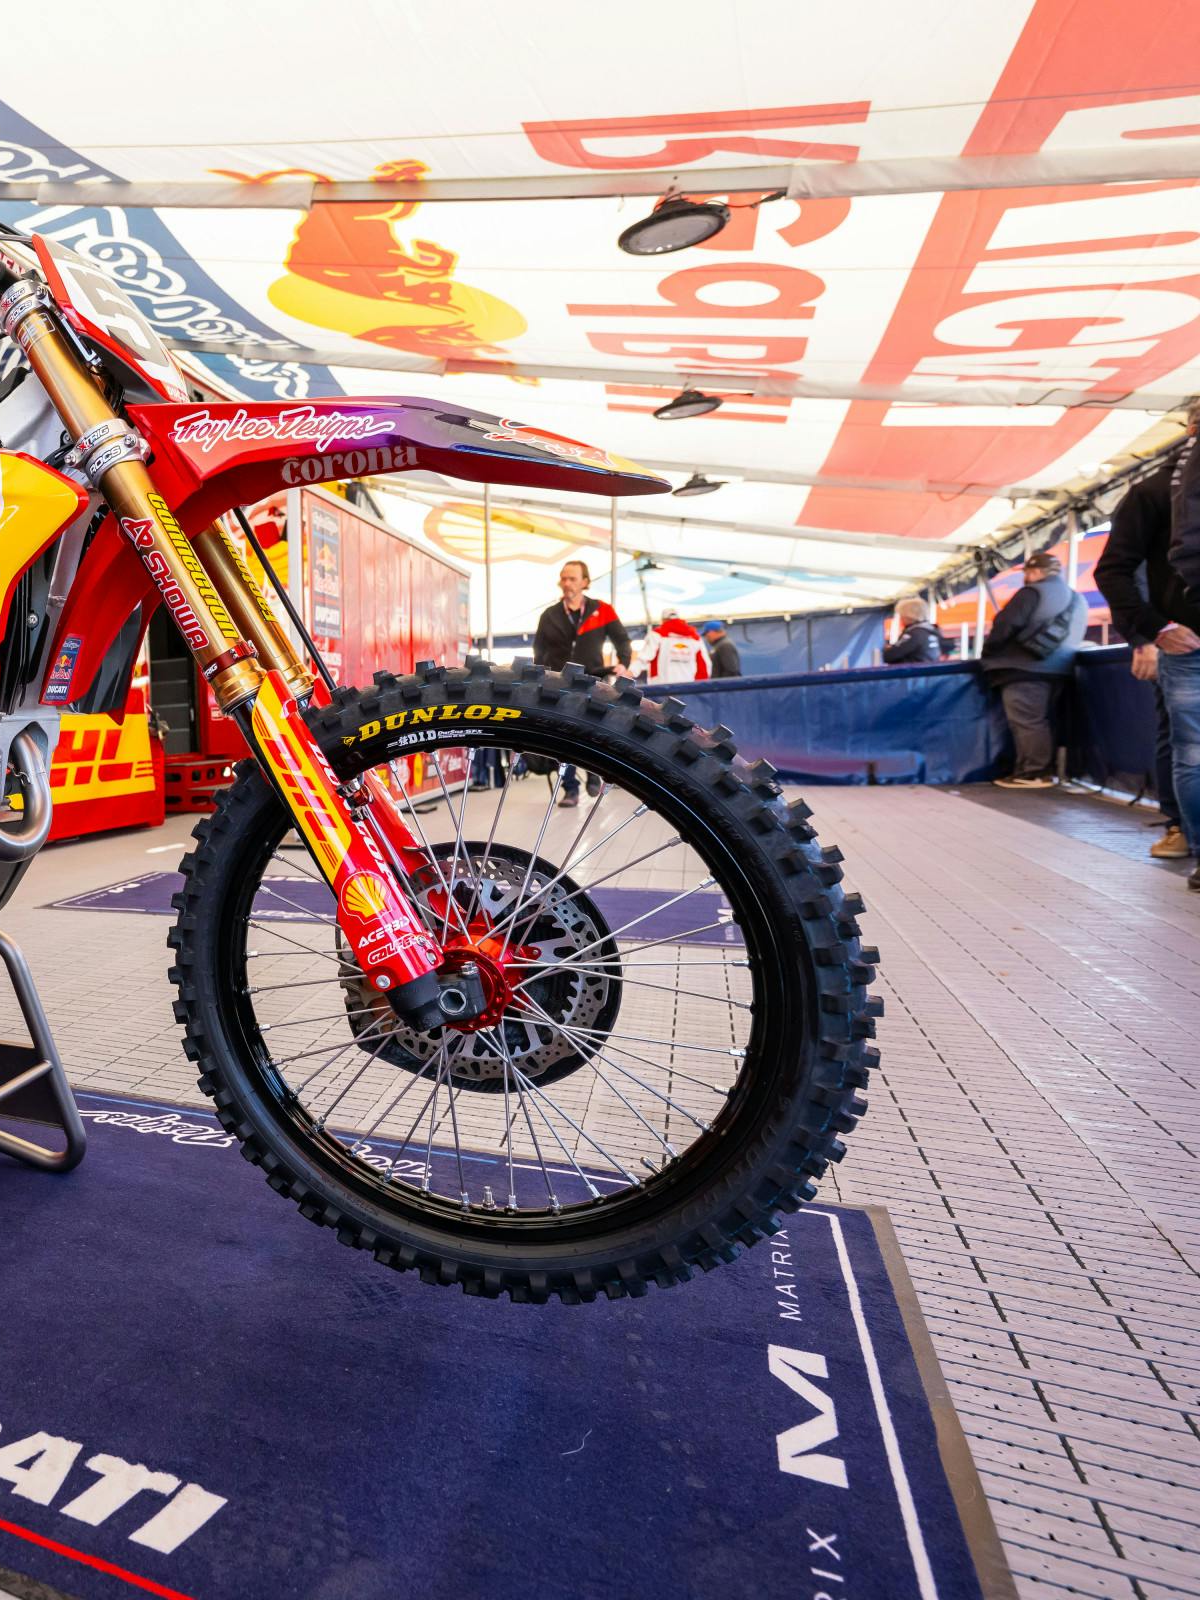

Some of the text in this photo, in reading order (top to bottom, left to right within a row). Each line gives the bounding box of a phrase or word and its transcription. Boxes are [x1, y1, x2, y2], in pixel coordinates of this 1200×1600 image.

[76, 424, 110, 451] XTRIG
[168, 406, 396, 452] Troy Lee Designs
[88, 445, 122, 478] ROCS
[281, 442, 420, 485] corona
[142, 550, 210, 651] SHOWA
[47, 685, 68, 694] DUCATI
[357, 704, 522, 743] DUNLOP
[50, 729, 134, 788] HL
[261, 734, 337, 843] DHL
[310, 740, 401, 892] DULOP
[369, 933, 422, 964] GALFE
